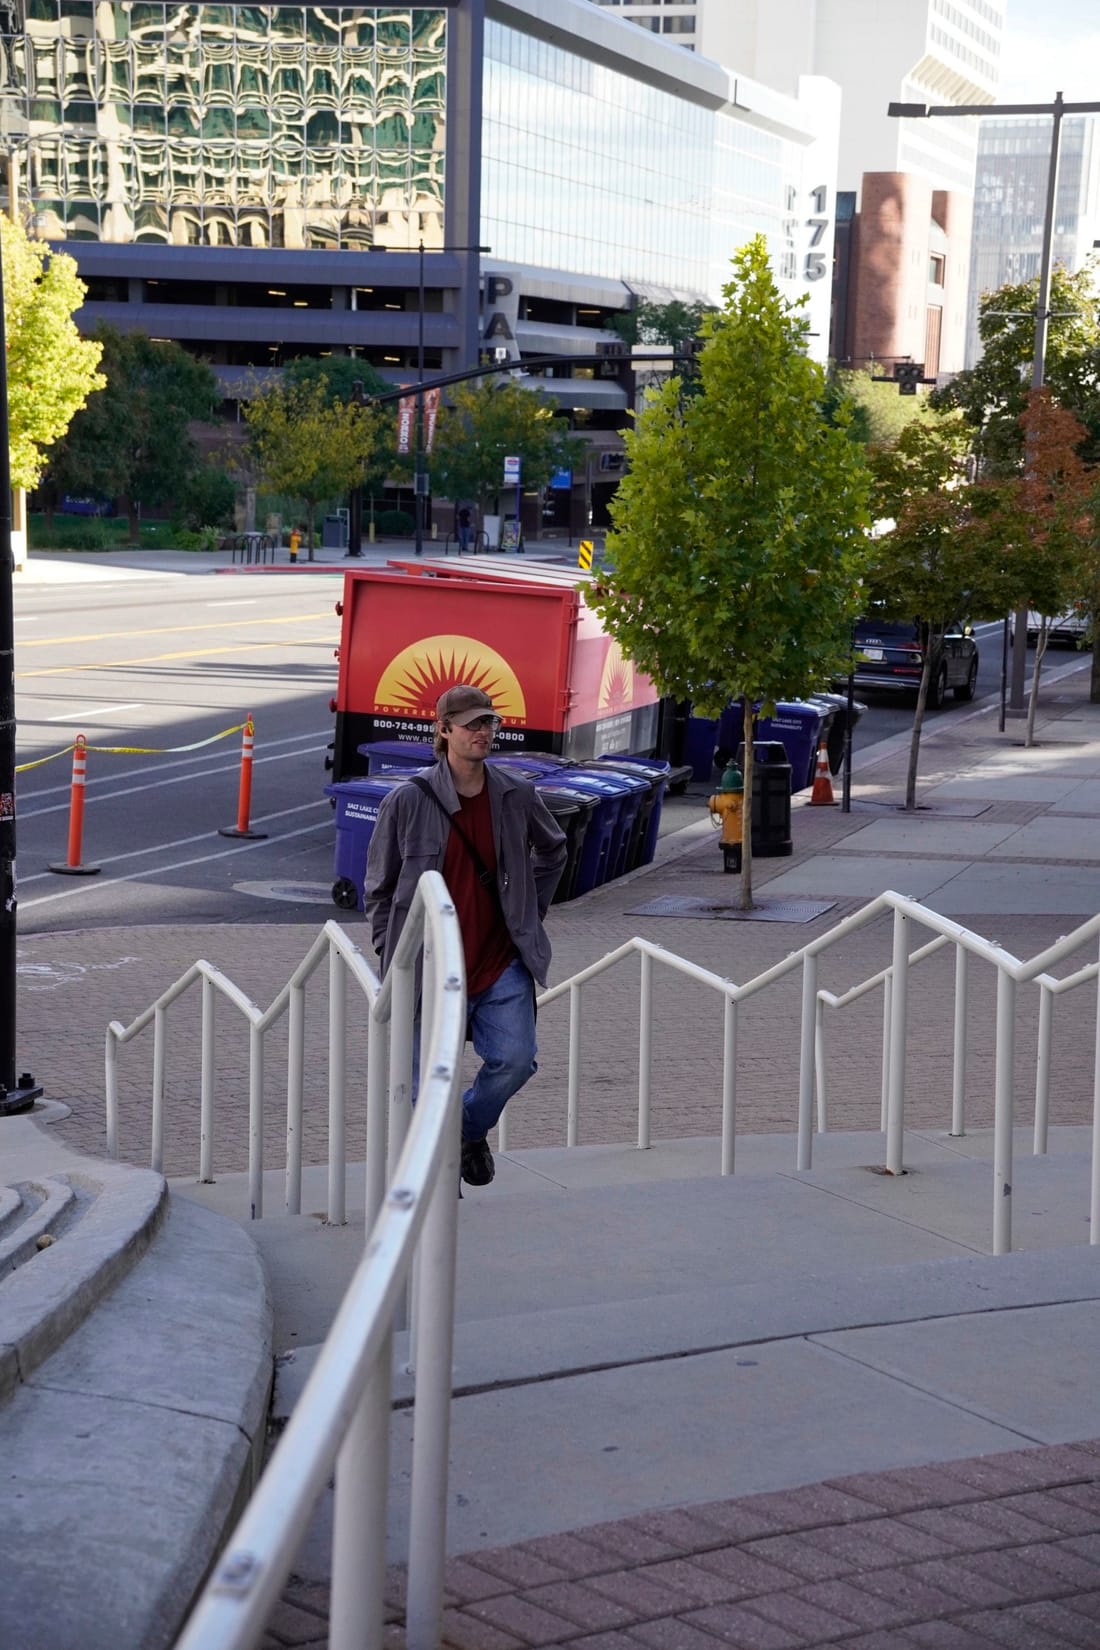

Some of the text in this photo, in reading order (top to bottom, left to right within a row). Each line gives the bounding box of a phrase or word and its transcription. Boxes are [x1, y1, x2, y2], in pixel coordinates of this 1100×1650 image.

[804, 185, 829, 282] 175
[374, 705, 436, 717] POWERED
[398, 734, 434, 745] www.ac
